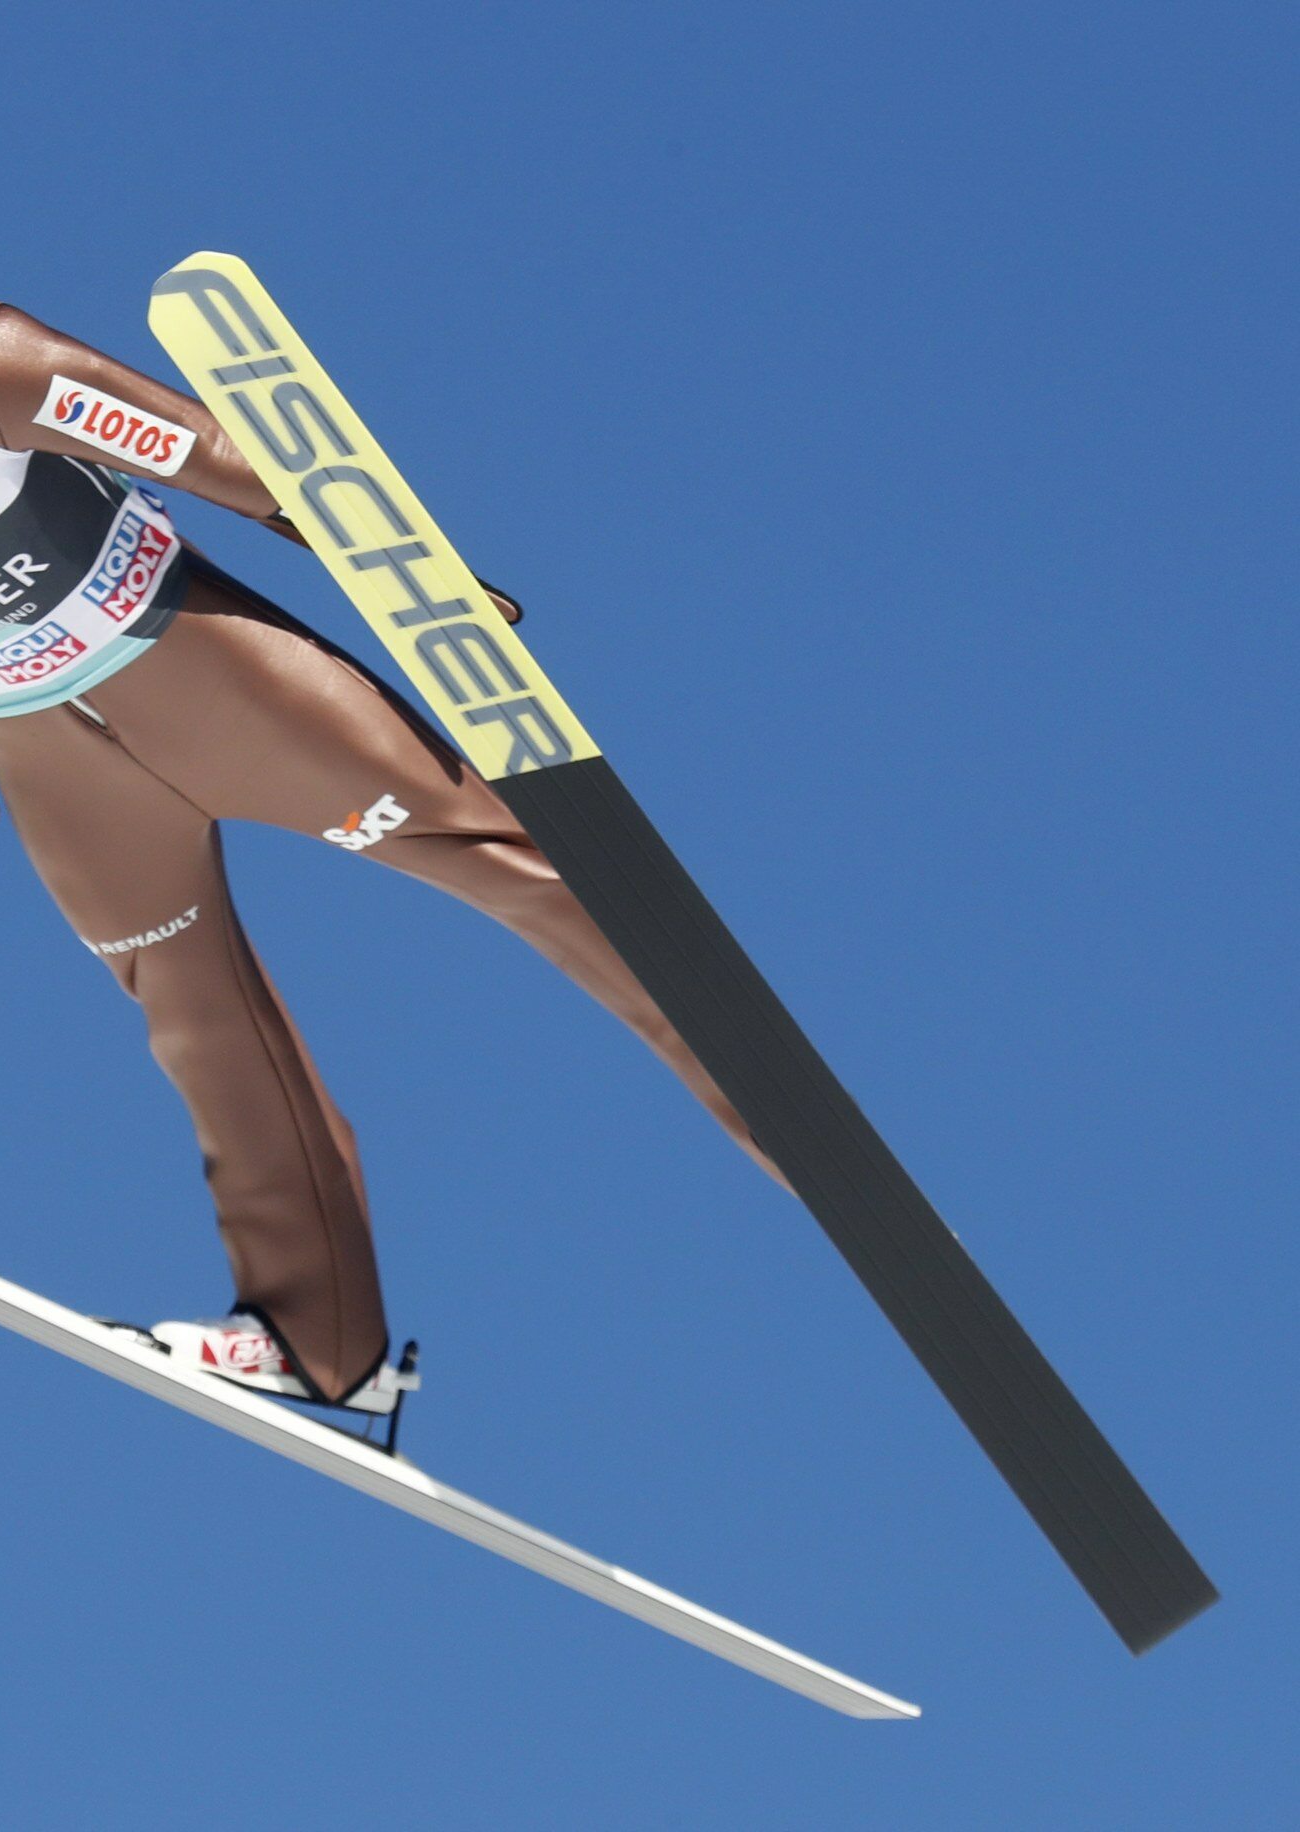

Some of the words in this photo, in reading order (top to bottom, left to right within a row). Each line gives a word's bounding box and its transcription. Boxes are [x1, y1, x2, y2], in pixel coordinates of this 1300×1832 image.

[83, 401, 179, 464] LOTOS
[84, 515, 142, 602] LIQUI
[151, 268, 573, 777] FISCHER
[103, 525, 166, 619] MOLY
[99, 906, 199, 954] RENAULT
